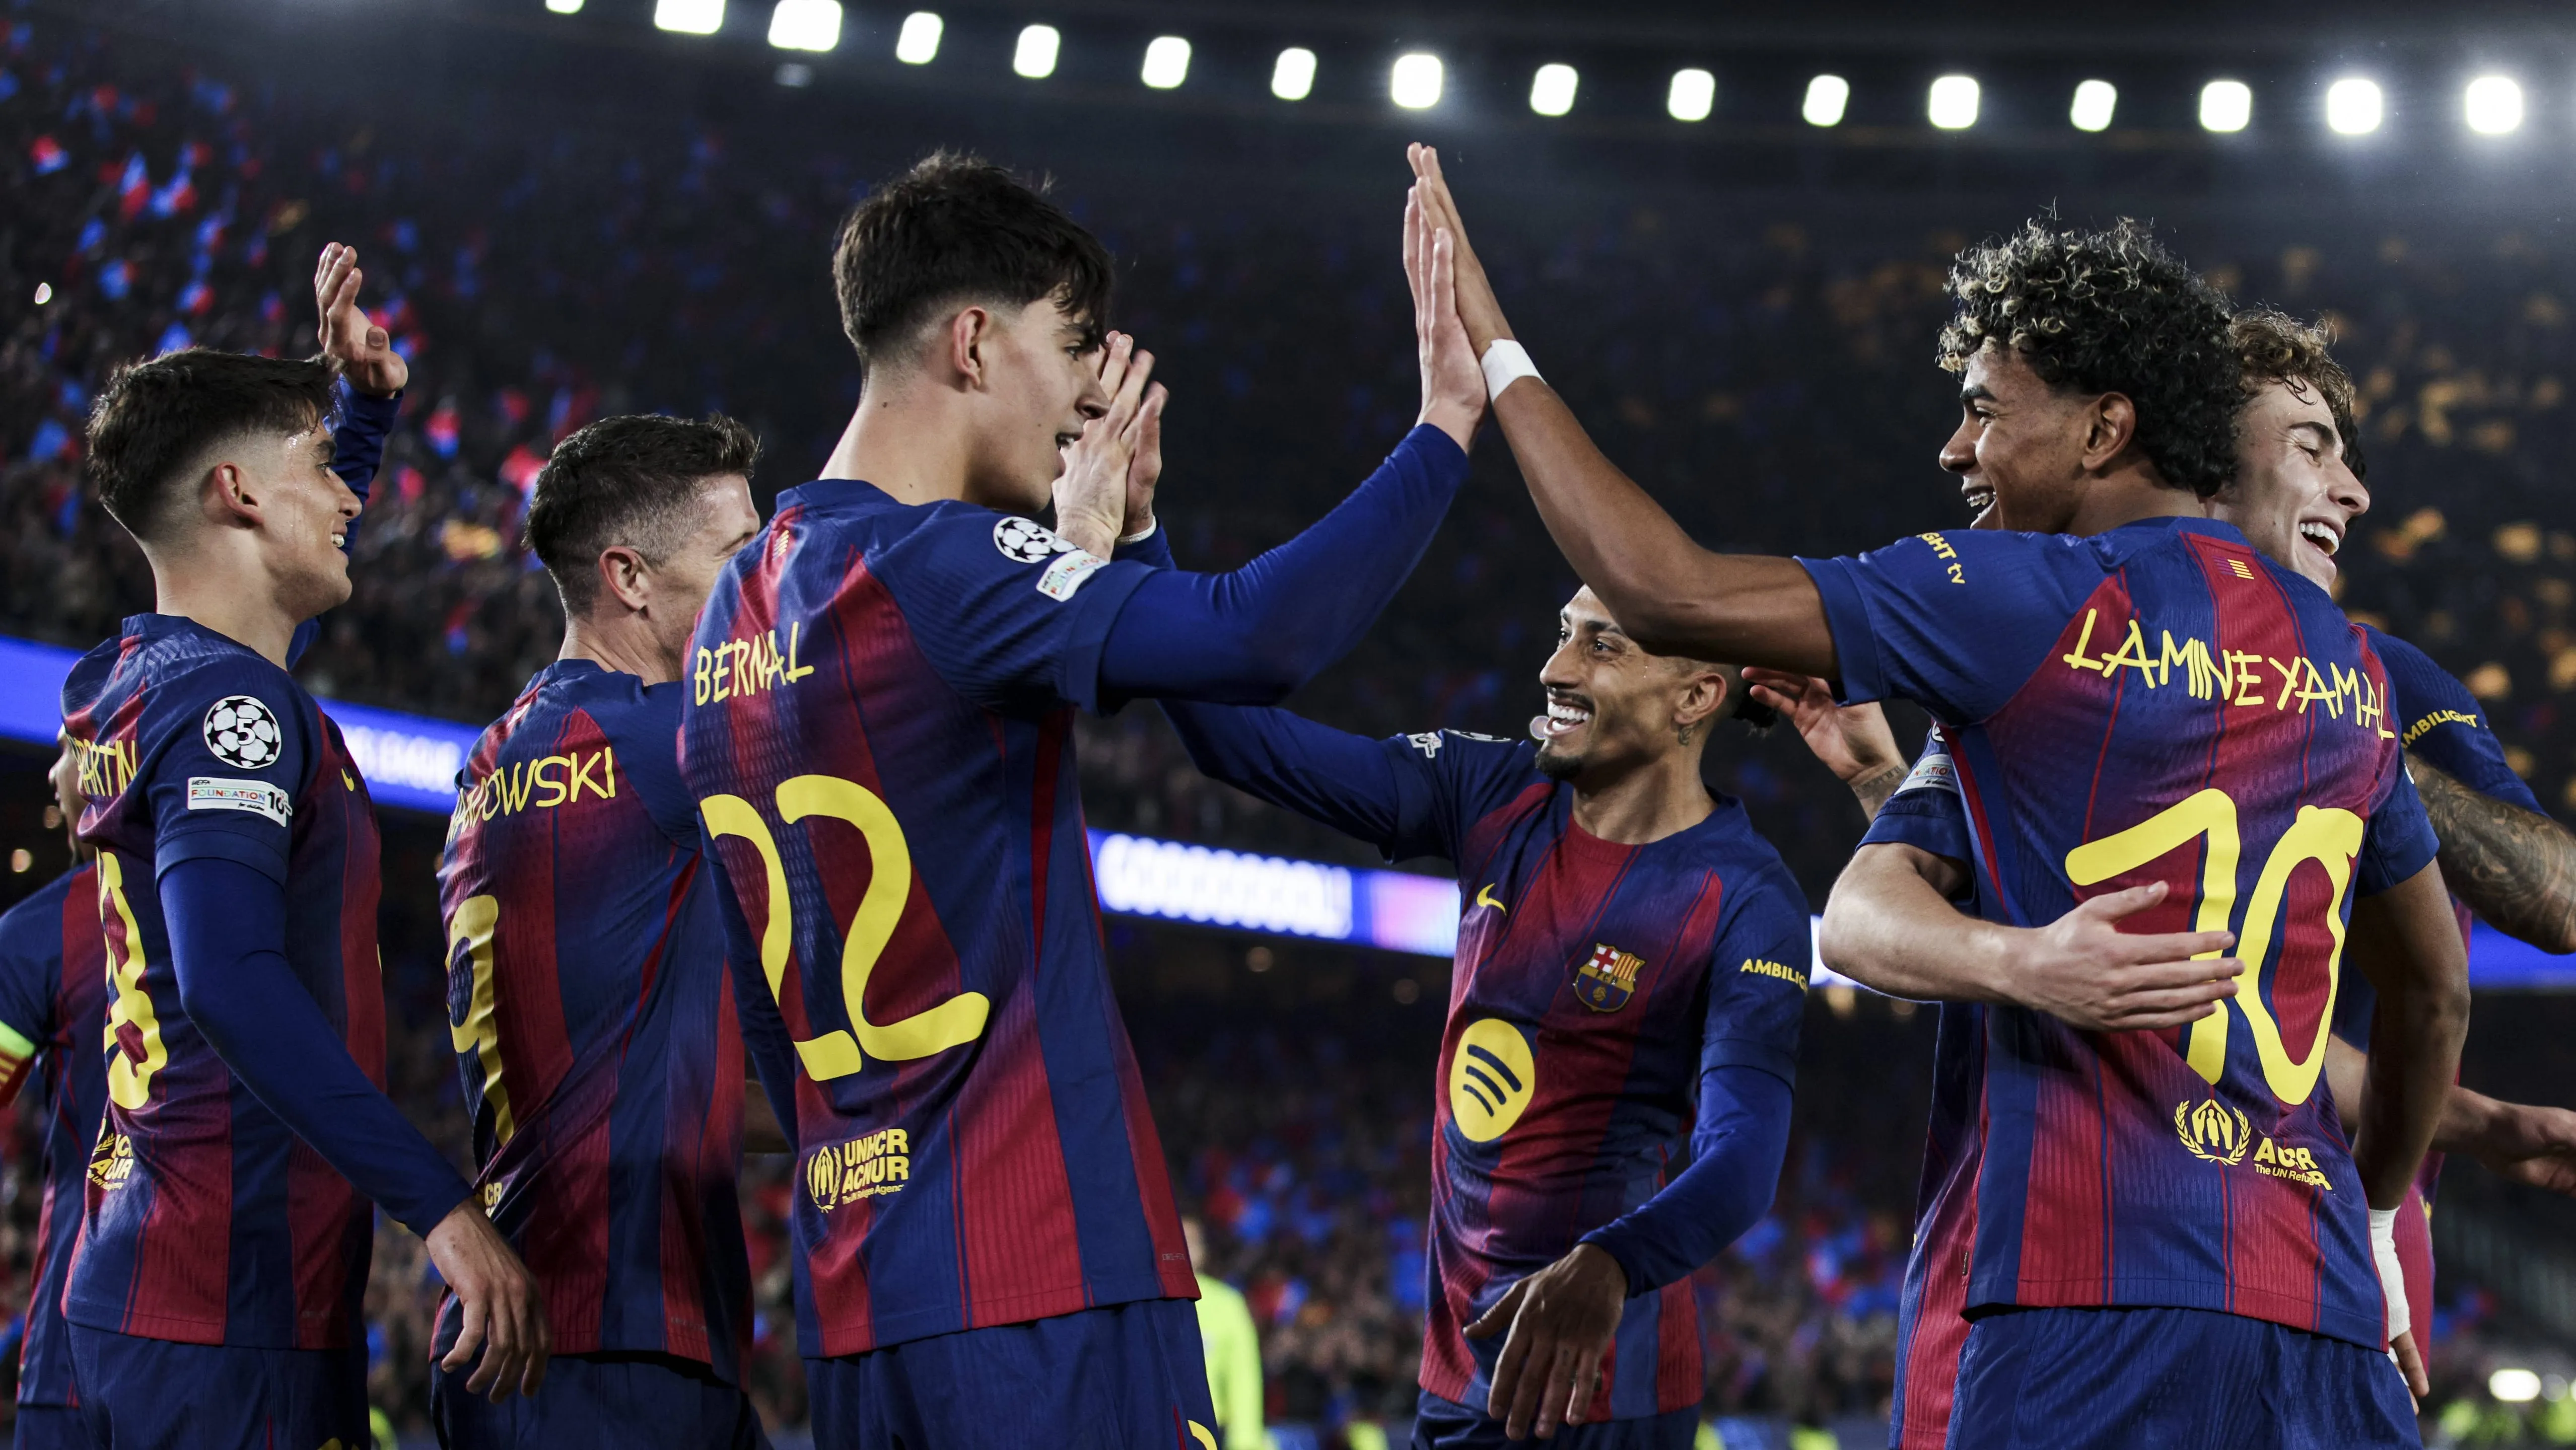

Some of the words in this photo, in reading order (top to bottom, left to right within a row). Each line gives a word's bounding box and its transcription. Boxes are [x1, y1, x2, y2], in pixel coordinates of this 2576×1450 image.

[1947, 562, 1966, 584] tv
[695, 621, 814, 706] BERNAL
[2063, 608, 2265, 707] LAMINE
[2269, 656, 2395, 740] YAMAL
[236, 717, 256, 746] 5
[191, 789, 265, 803] FOUNDATION
[700, 774, 990, 1081] 22
[2065, 788, 2363, 1105] 10
[445, 894, 514, 1147] 9
[844, 1128, 909, 1168] UNHCR
[842, 1155, 910, 1194] ACNUR
[2254, 1163, 2271, 1175] The
[2272, 1167, 2288, 1179] UN
[2288, 1170, 2317, 1186] Refug
